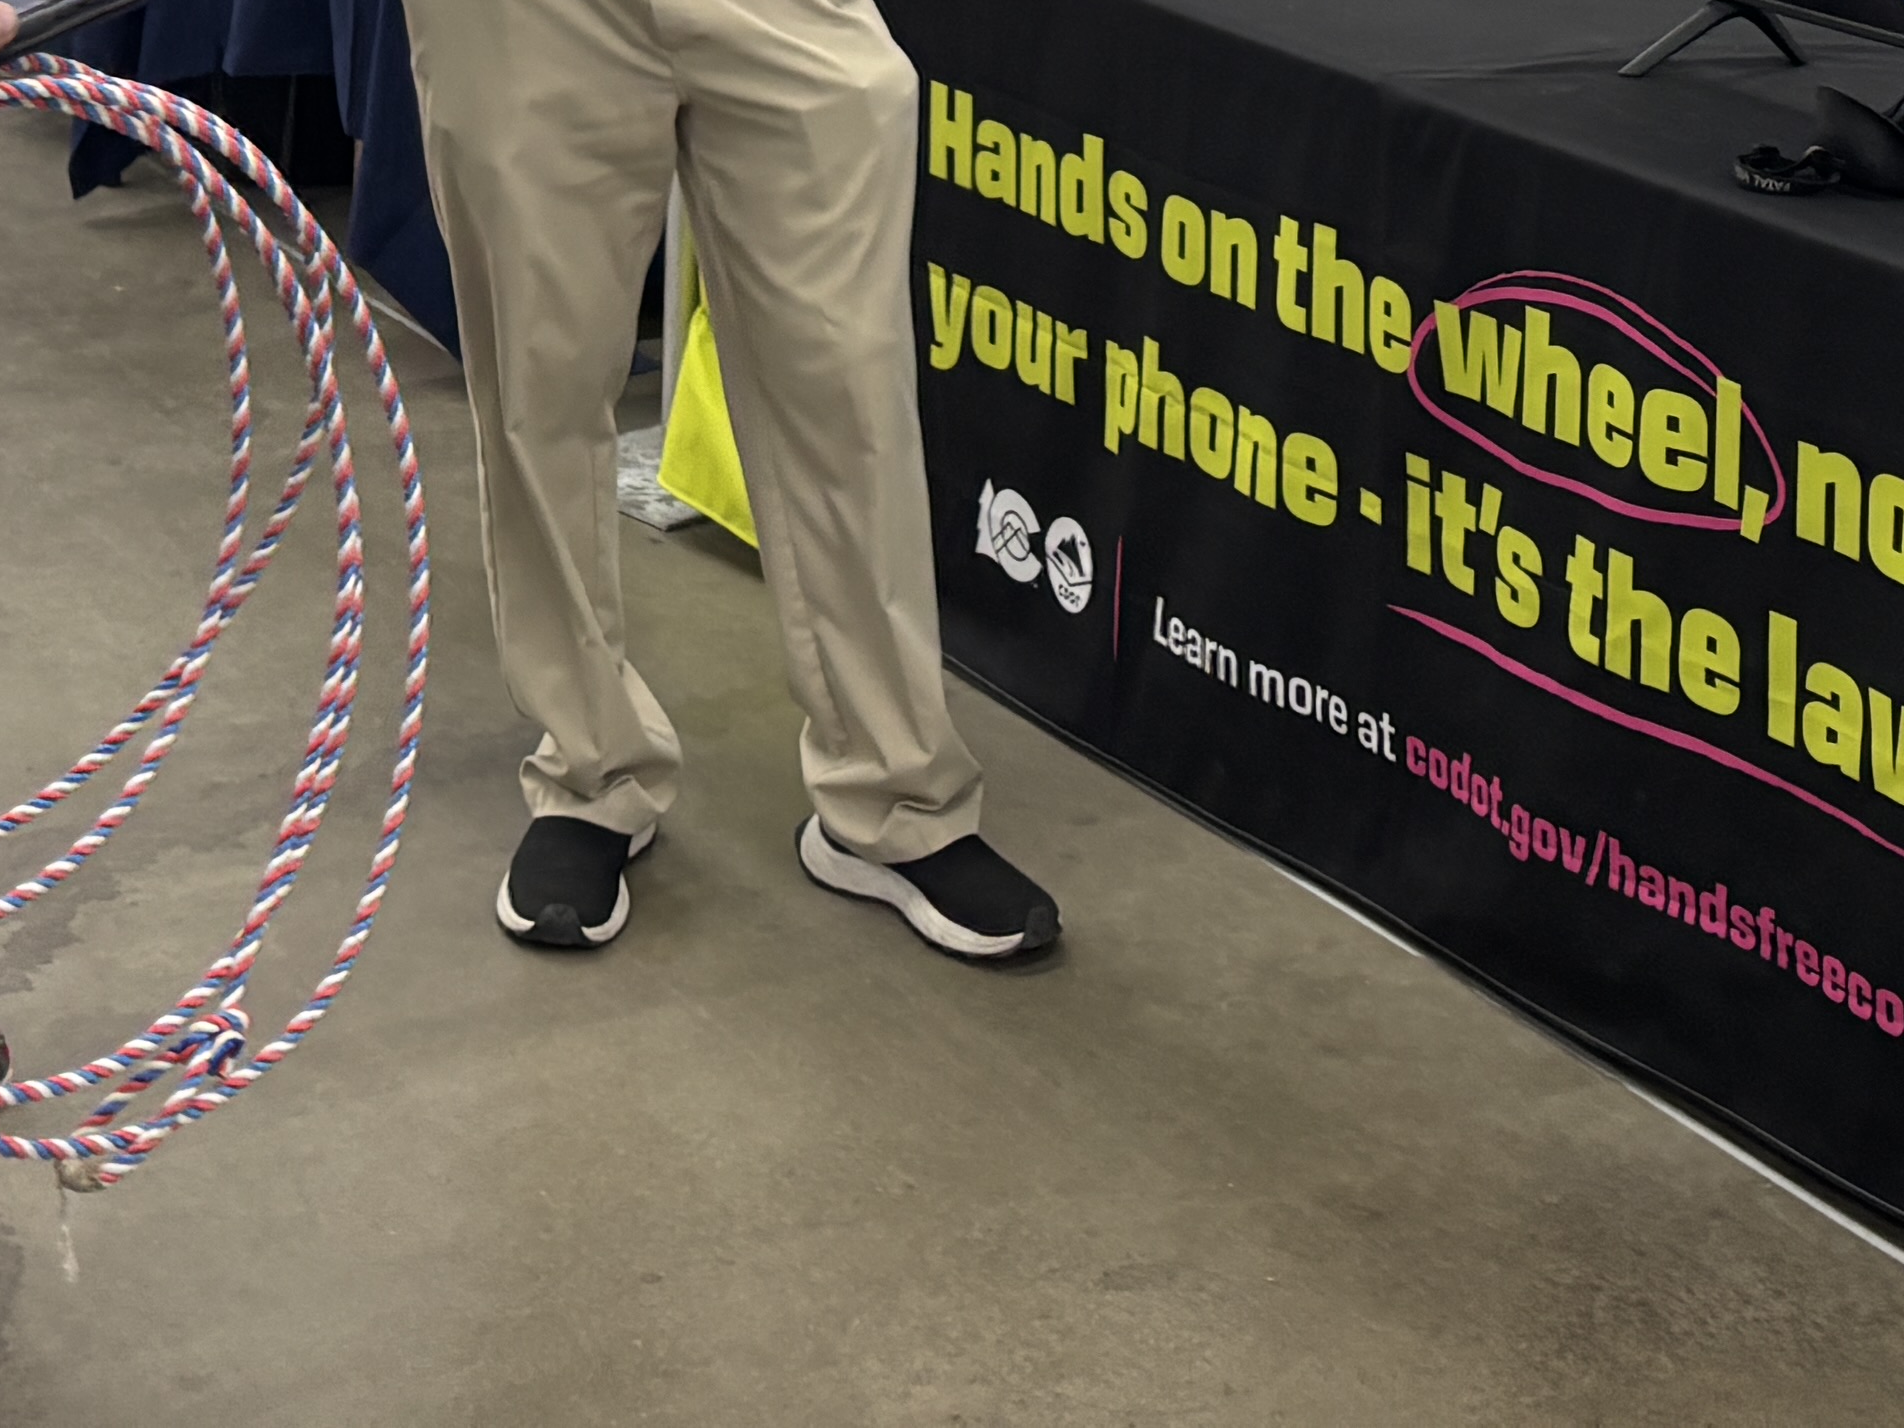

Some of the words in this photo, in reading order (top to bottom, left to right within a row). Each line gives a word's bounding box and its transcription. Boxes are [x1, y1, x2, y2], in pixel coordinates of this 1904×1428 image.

[927, 261, 1088, 407] your
[1104, 335, 1338, 527] phone
[1359, 487, 1382, 526] -
[1406, 452, 1543, 629] it's
[1566, 535, 1741, 716] the
[929, 80, 1149, 260] Hands
[1160, 195, 1258, 311] on
[1273, 214, 1412, 374] the
[1433, 298, 1770, 544] wheel,
[1153, 596, 1239, 689] Learn
[1249, 660, 1348, 736] more
[1358, 711, 1397, 762] at
